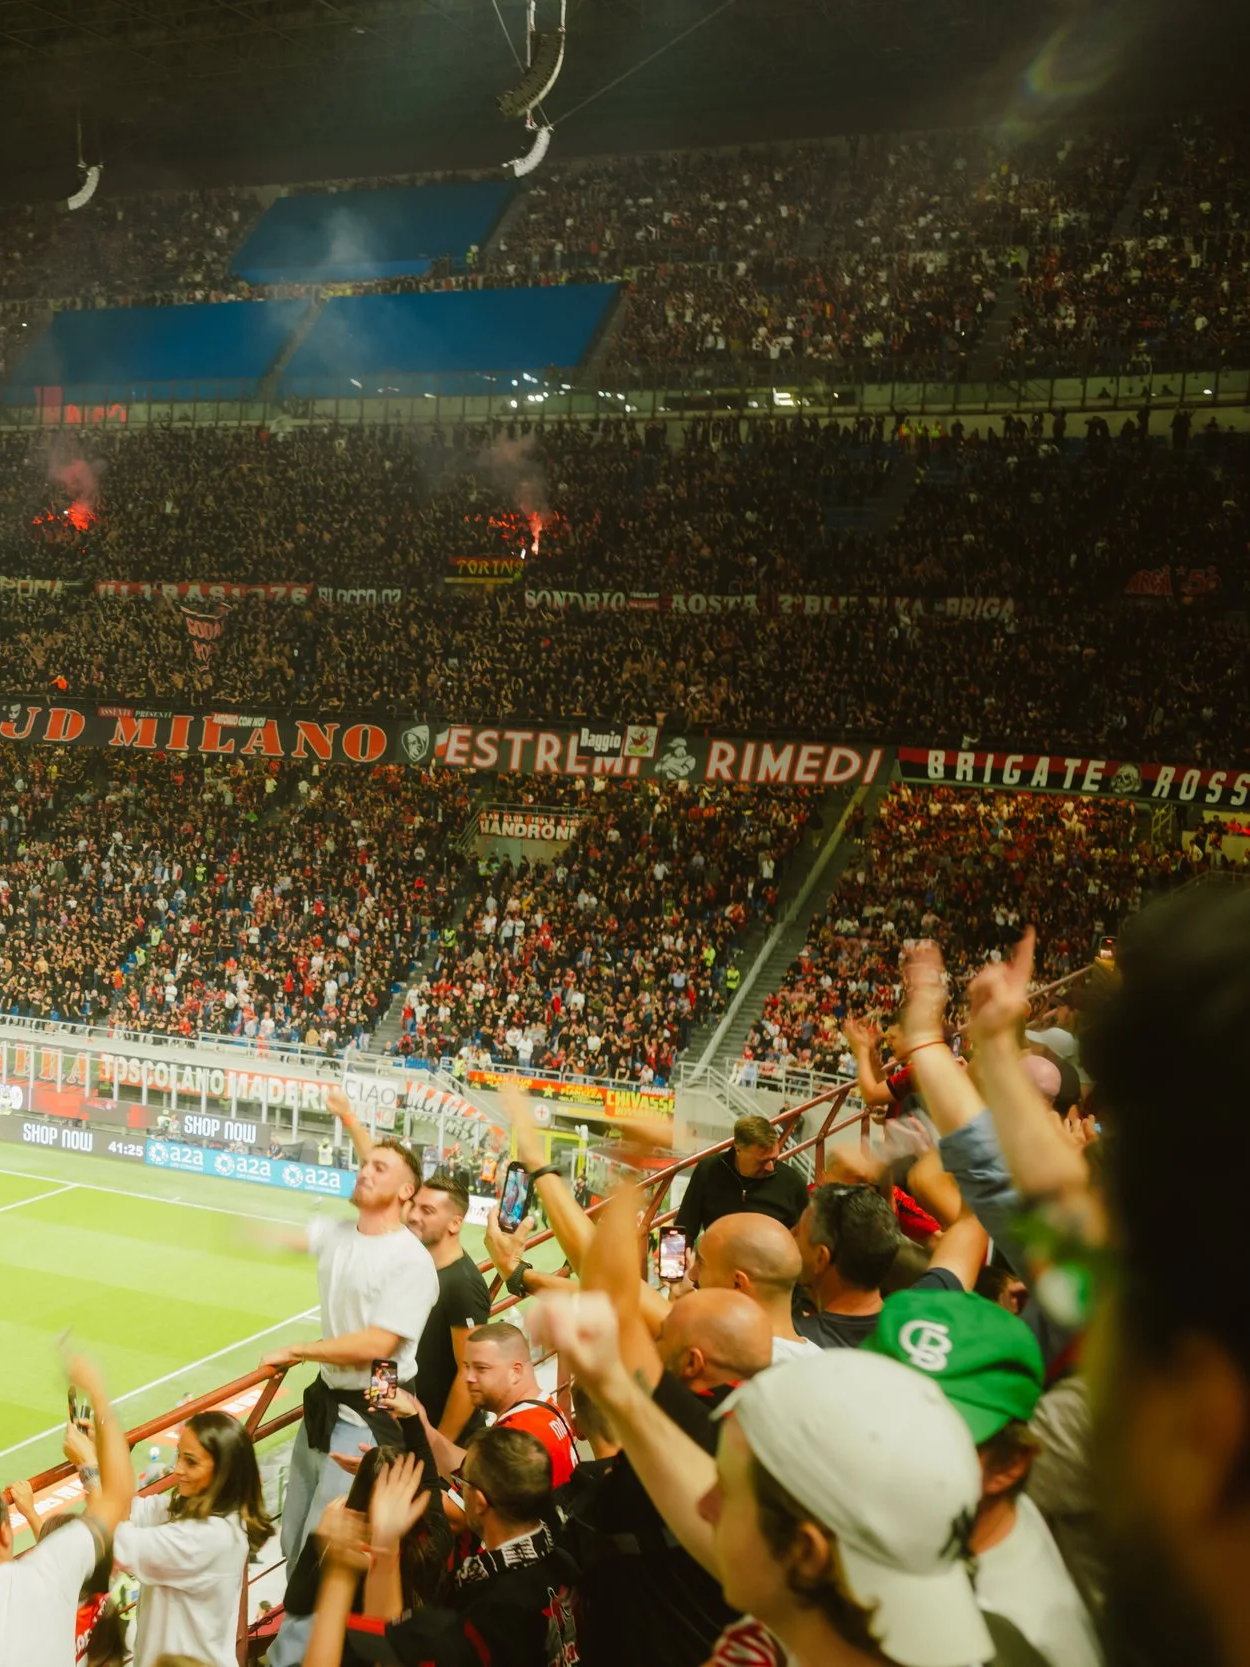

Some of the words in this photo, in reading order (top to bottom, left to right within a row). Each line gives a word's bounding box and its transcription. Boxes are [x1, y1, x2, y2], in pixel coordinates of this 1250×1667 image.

[108, 713, 389, 764] MILANO
[579, 726, 622, 751] Baggio
[703, 738, 884, 785] RIMEDI
[927, 749, 1107, 793] BRIGATE
[100, 1052, 226, 1095] TOSCOLANO
[344, 1079, 397, 1106] CIAO
[22, 1122, 60, 1145] SHOP
[184, 1114, 221, 1138] SHOP
[108, 1140, 144, 1158] 41:25
[169, 1143, 204, 1167] a2a
[236, 1156, 272, 1177] a2a
[305, 1167, 341, 1189] a2a
